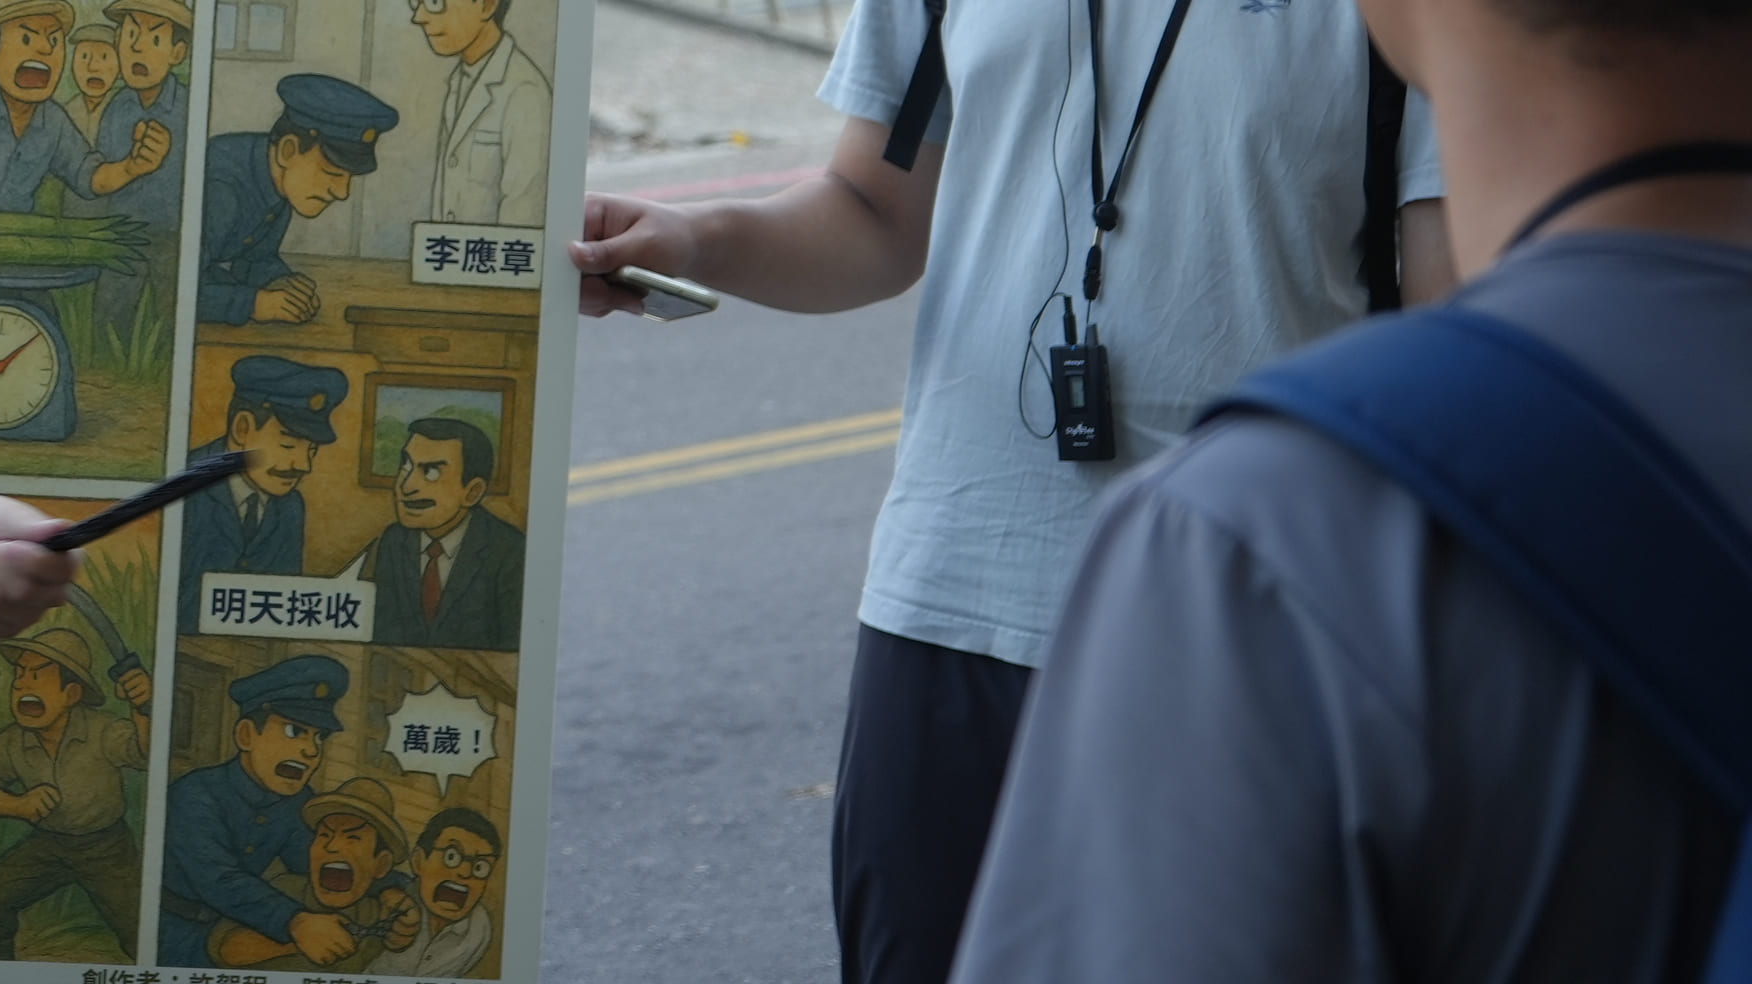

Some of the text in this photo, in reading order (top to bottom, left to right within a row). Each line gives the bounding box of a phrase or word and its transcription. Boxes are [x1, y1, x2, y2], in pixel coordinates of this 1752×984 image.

[424, 235, 535, 276] 李應章
[211, 587, 362, 629] 明天採收
[402, 723, 481, 755] 萬歲！
